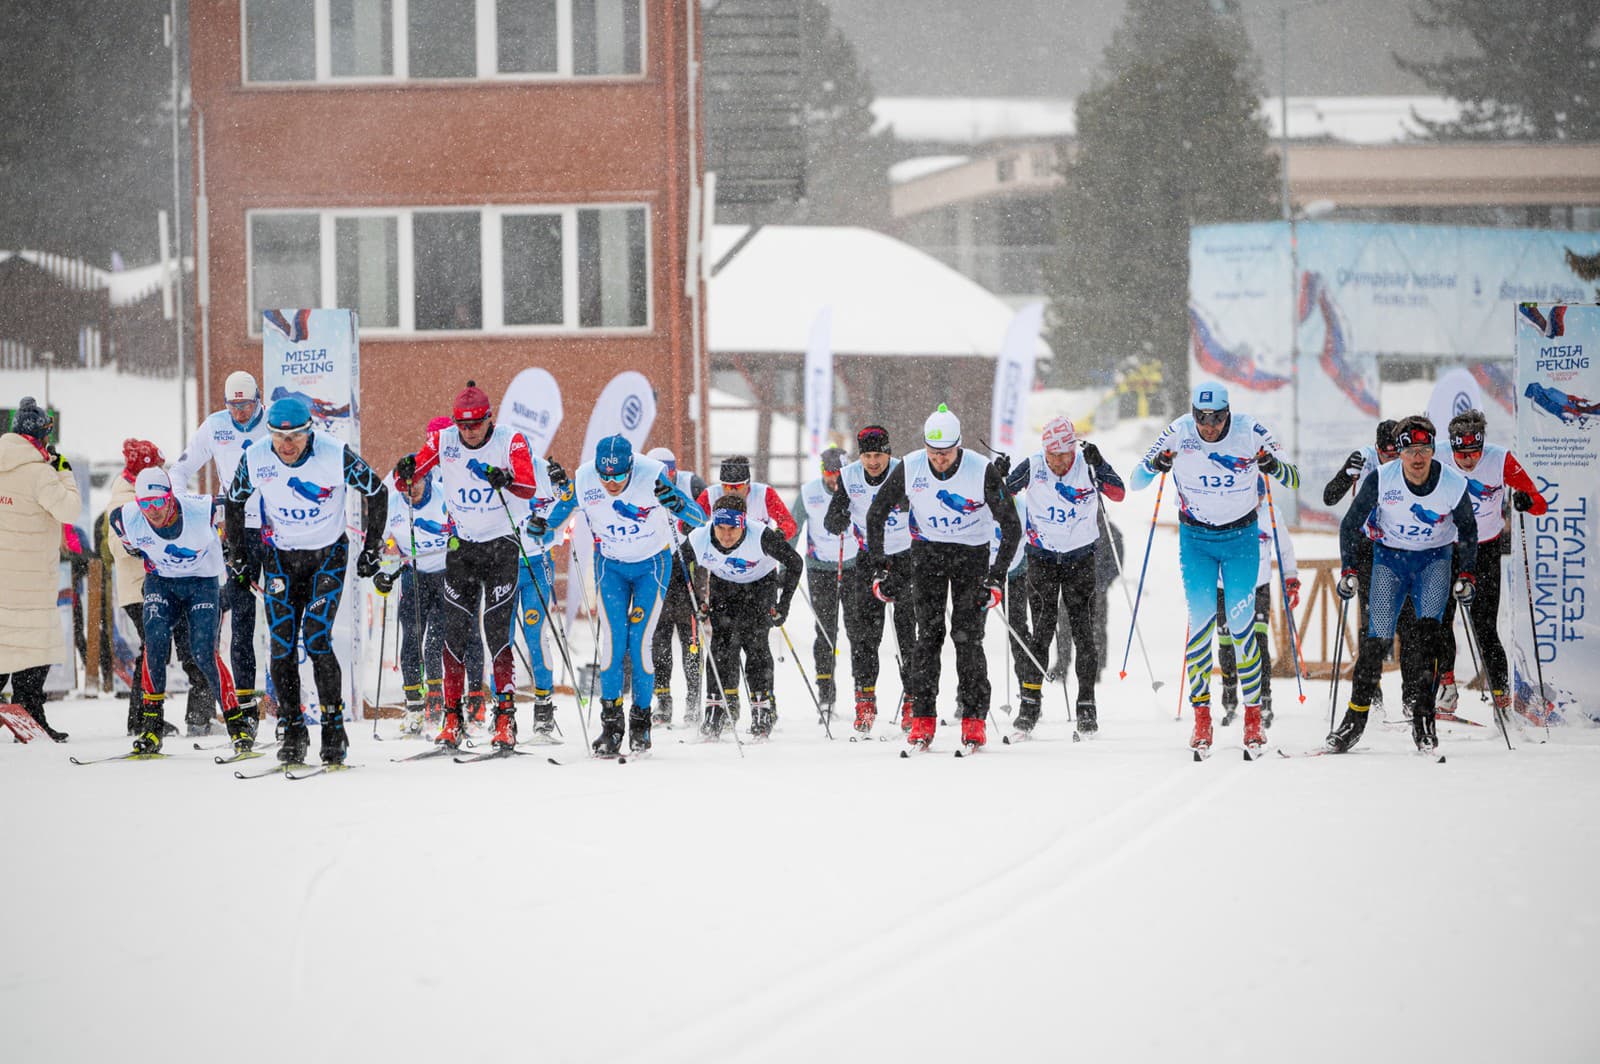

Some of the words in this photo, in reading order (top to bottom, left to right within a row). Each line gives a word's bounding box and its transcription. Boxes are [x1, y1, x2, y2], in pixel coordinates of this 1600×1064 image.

[286, 349, 327, 362] MISIA
[1541, 345, 1583, 358] MISIA
[282, 361, 334, 375] PEKING
[1536, 357, 1590, 371] PEKING
[601, 457, 618, 465] DNB
[1199, 475, 1235, 487] 133
[458, 488, 494, 503] 107
[1047, 506, 1076, 523] 134
[928, 516, 962, 528] 114
[607, 524, 640, 536] 113
[1396, 525, 1433, 536] 124
[1562, 497, 1586, 642] FESTIVAL
[492, 583, 513, 602] Rex
